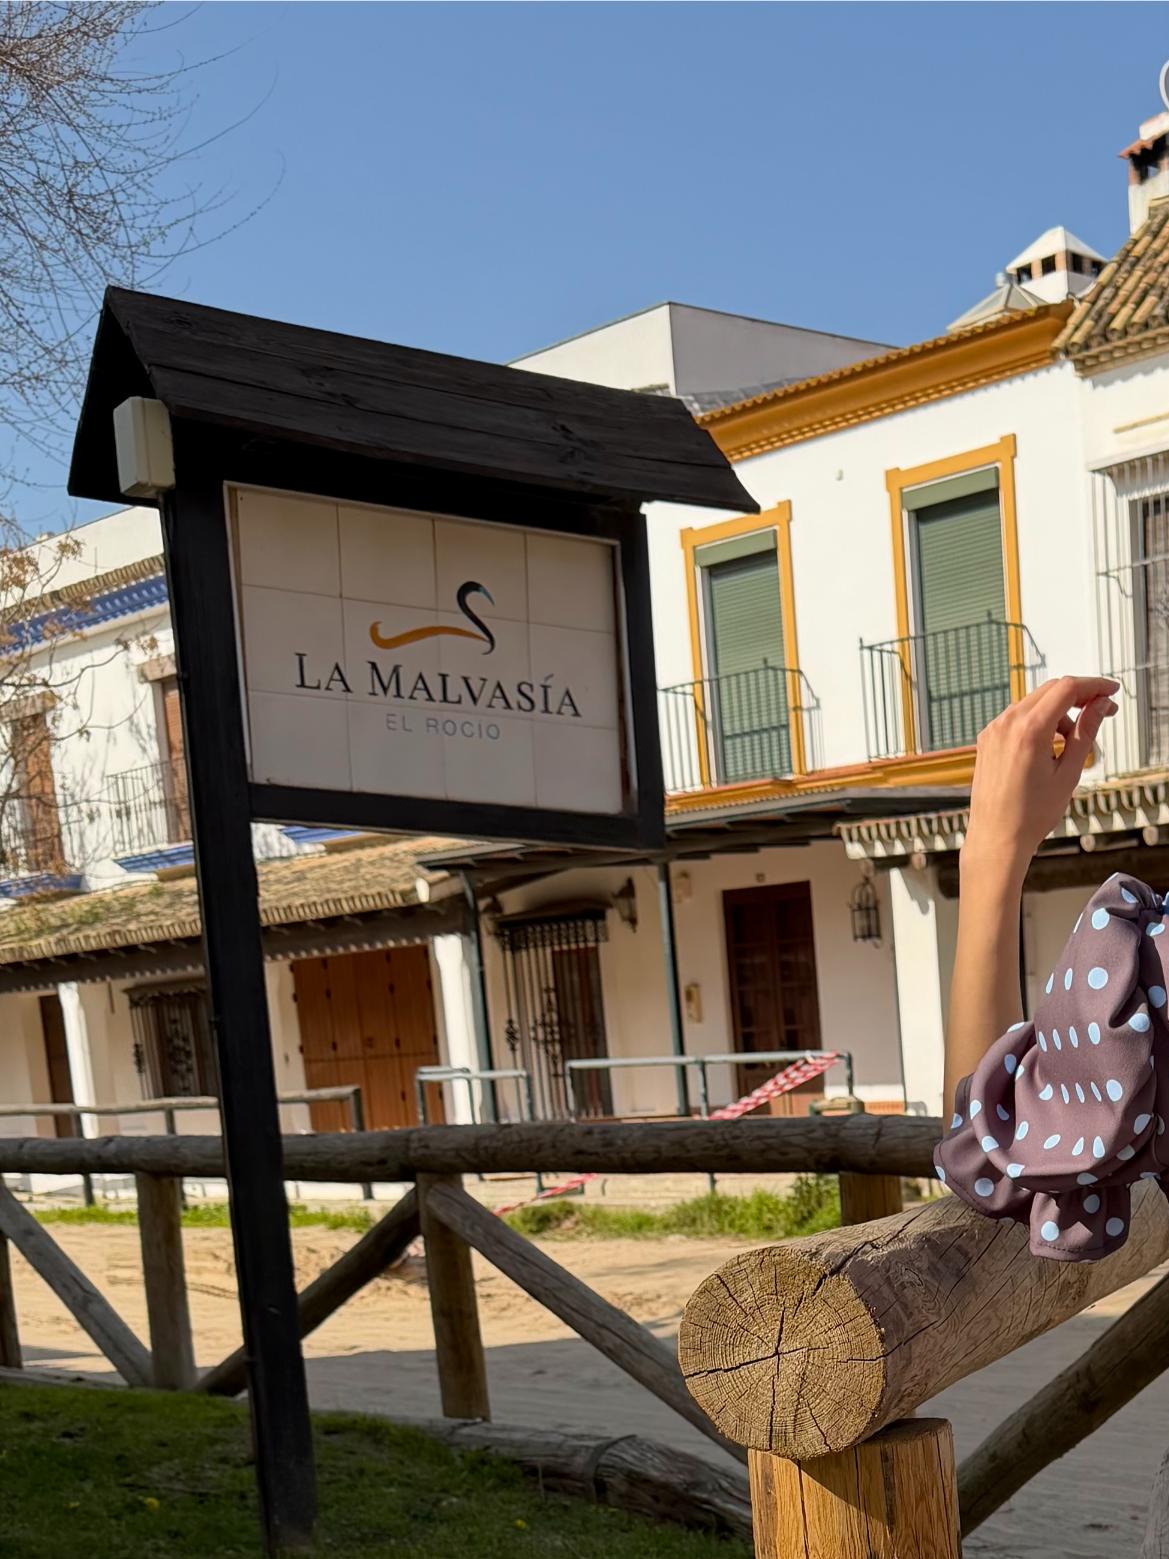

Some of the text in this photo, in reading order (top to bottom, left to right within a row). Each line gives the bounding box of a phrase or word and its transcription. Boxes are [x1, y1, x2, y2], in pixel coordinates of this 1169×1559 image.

[294, 652, 582, 717] LA MALVASÍA
[386, 713, 500, 740] EL ROCIO
